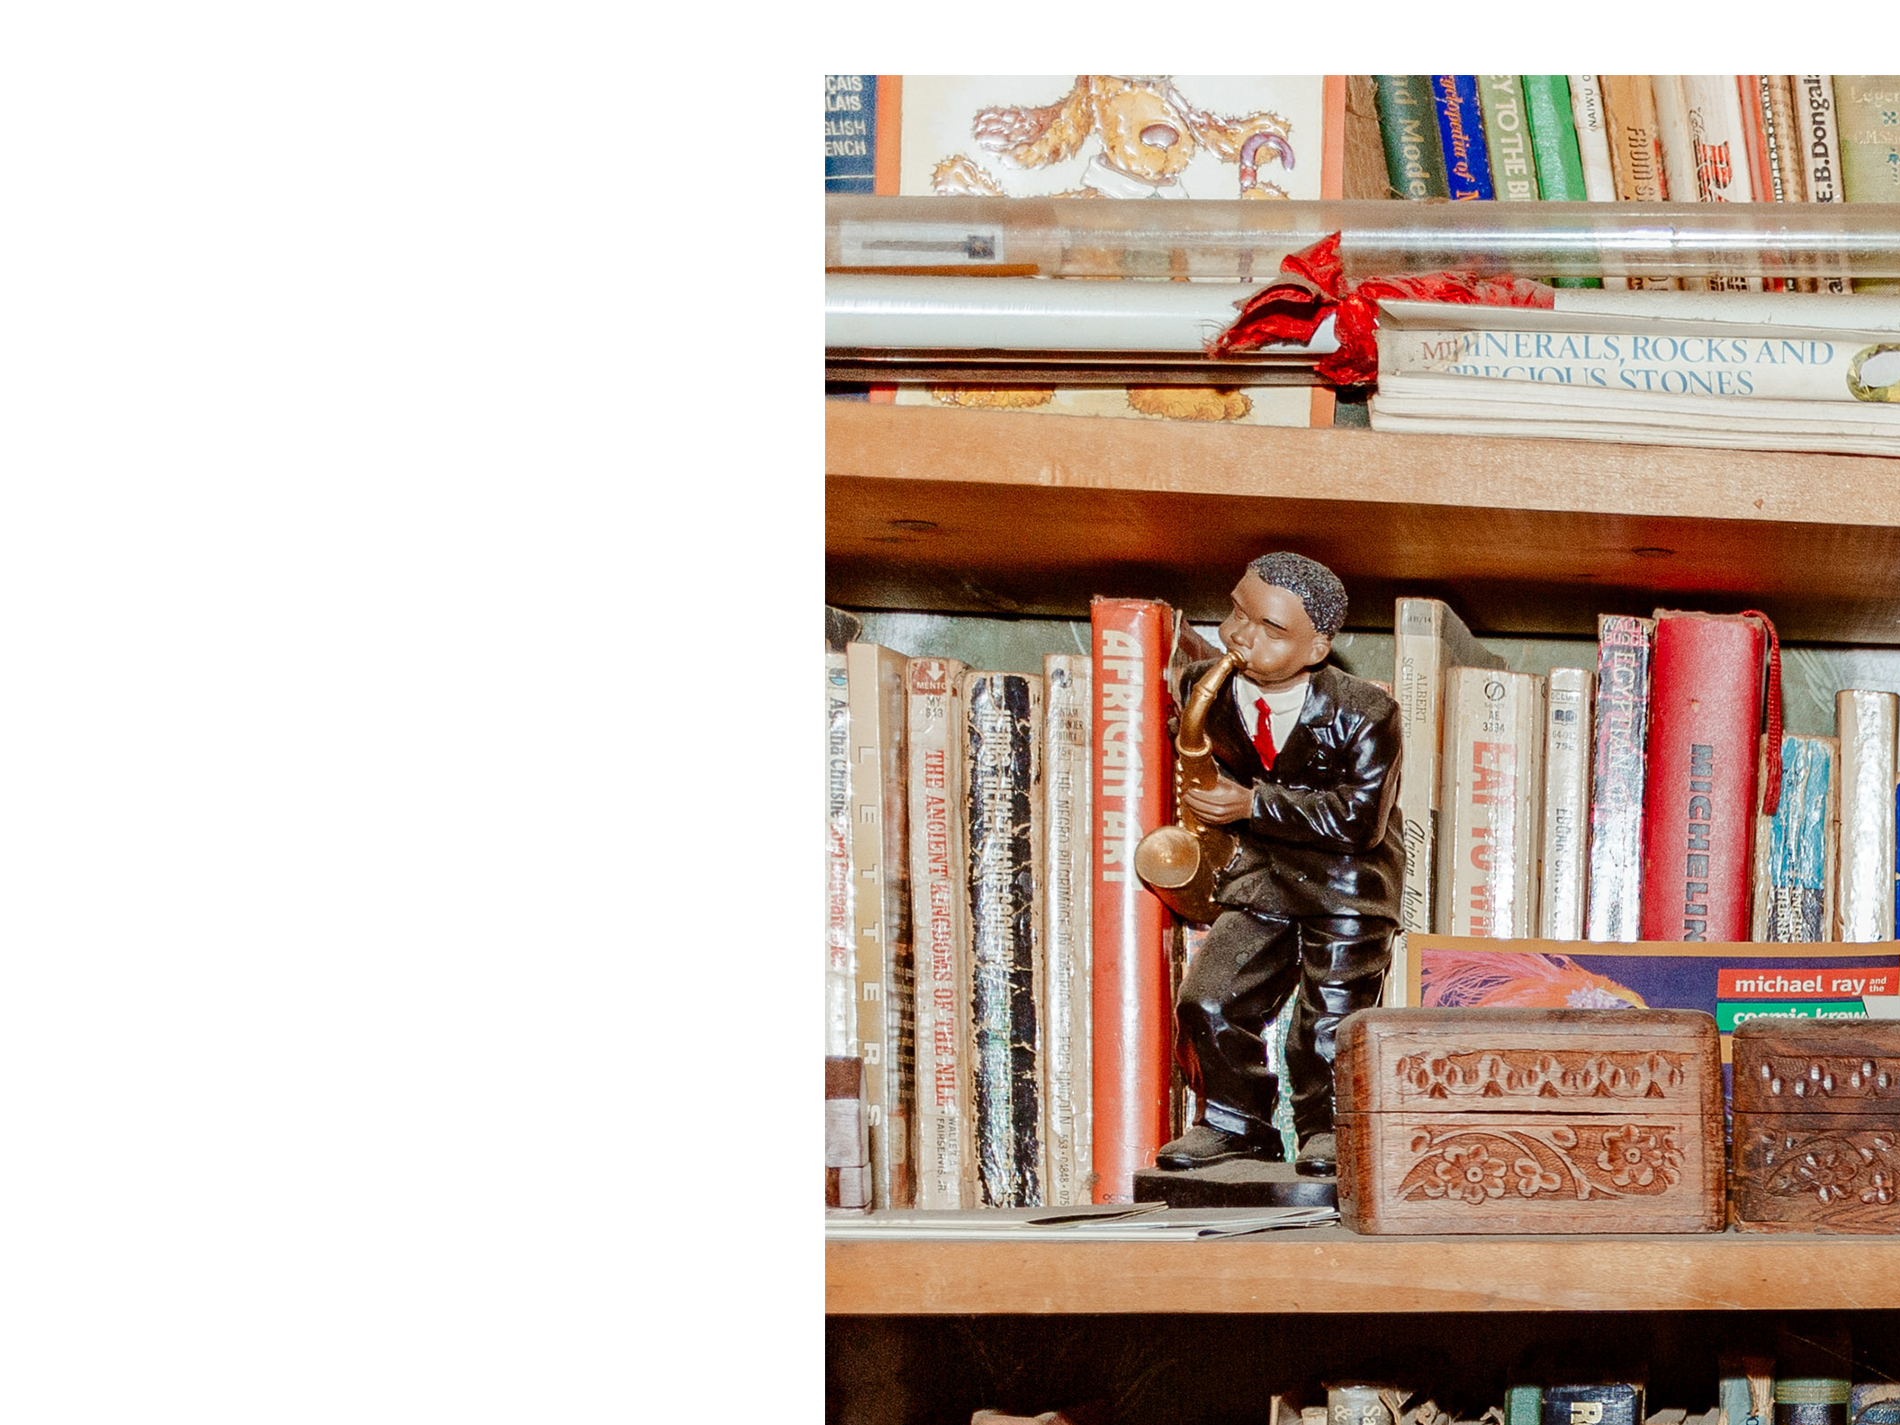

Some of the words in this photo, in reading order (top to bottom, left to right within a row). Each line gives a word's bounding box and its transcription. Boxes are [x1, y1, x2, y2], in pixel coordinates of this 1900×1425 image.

[1501, 132, 1528, 177] THE
[1634, 331, 1750, 367] ROCKS
[1755, 338, 1835, 368] AND
[1618, 366, 1755, 397] STONES
[1102, 629, 1145, 798] AFRICAN
[1416, 672, 1428, 725] ALBERT
[925, 749, 945, 790] THE
[926, 797, 949, 879] ANCIENT
[1058, 799, 1072, 846] NEGRO
[1102, 810, 1145, 893] ART
[857, 745, 882, 1128] LETTERS
[930, 882, 956, 985] KINGDOMS
[931, 986, 956, 1013] OF
[1734, 975, 1830, 995] michael
[1832, 977, 1866, 1000] ray
[1869, 976, 1888, 985] and
[1869, 984, 1886, 993] the
[933, 1017, 957, 1057] THE
[935, 1060, 959, 1108] NILE
[1334, 1405, 1352, 1422] &
